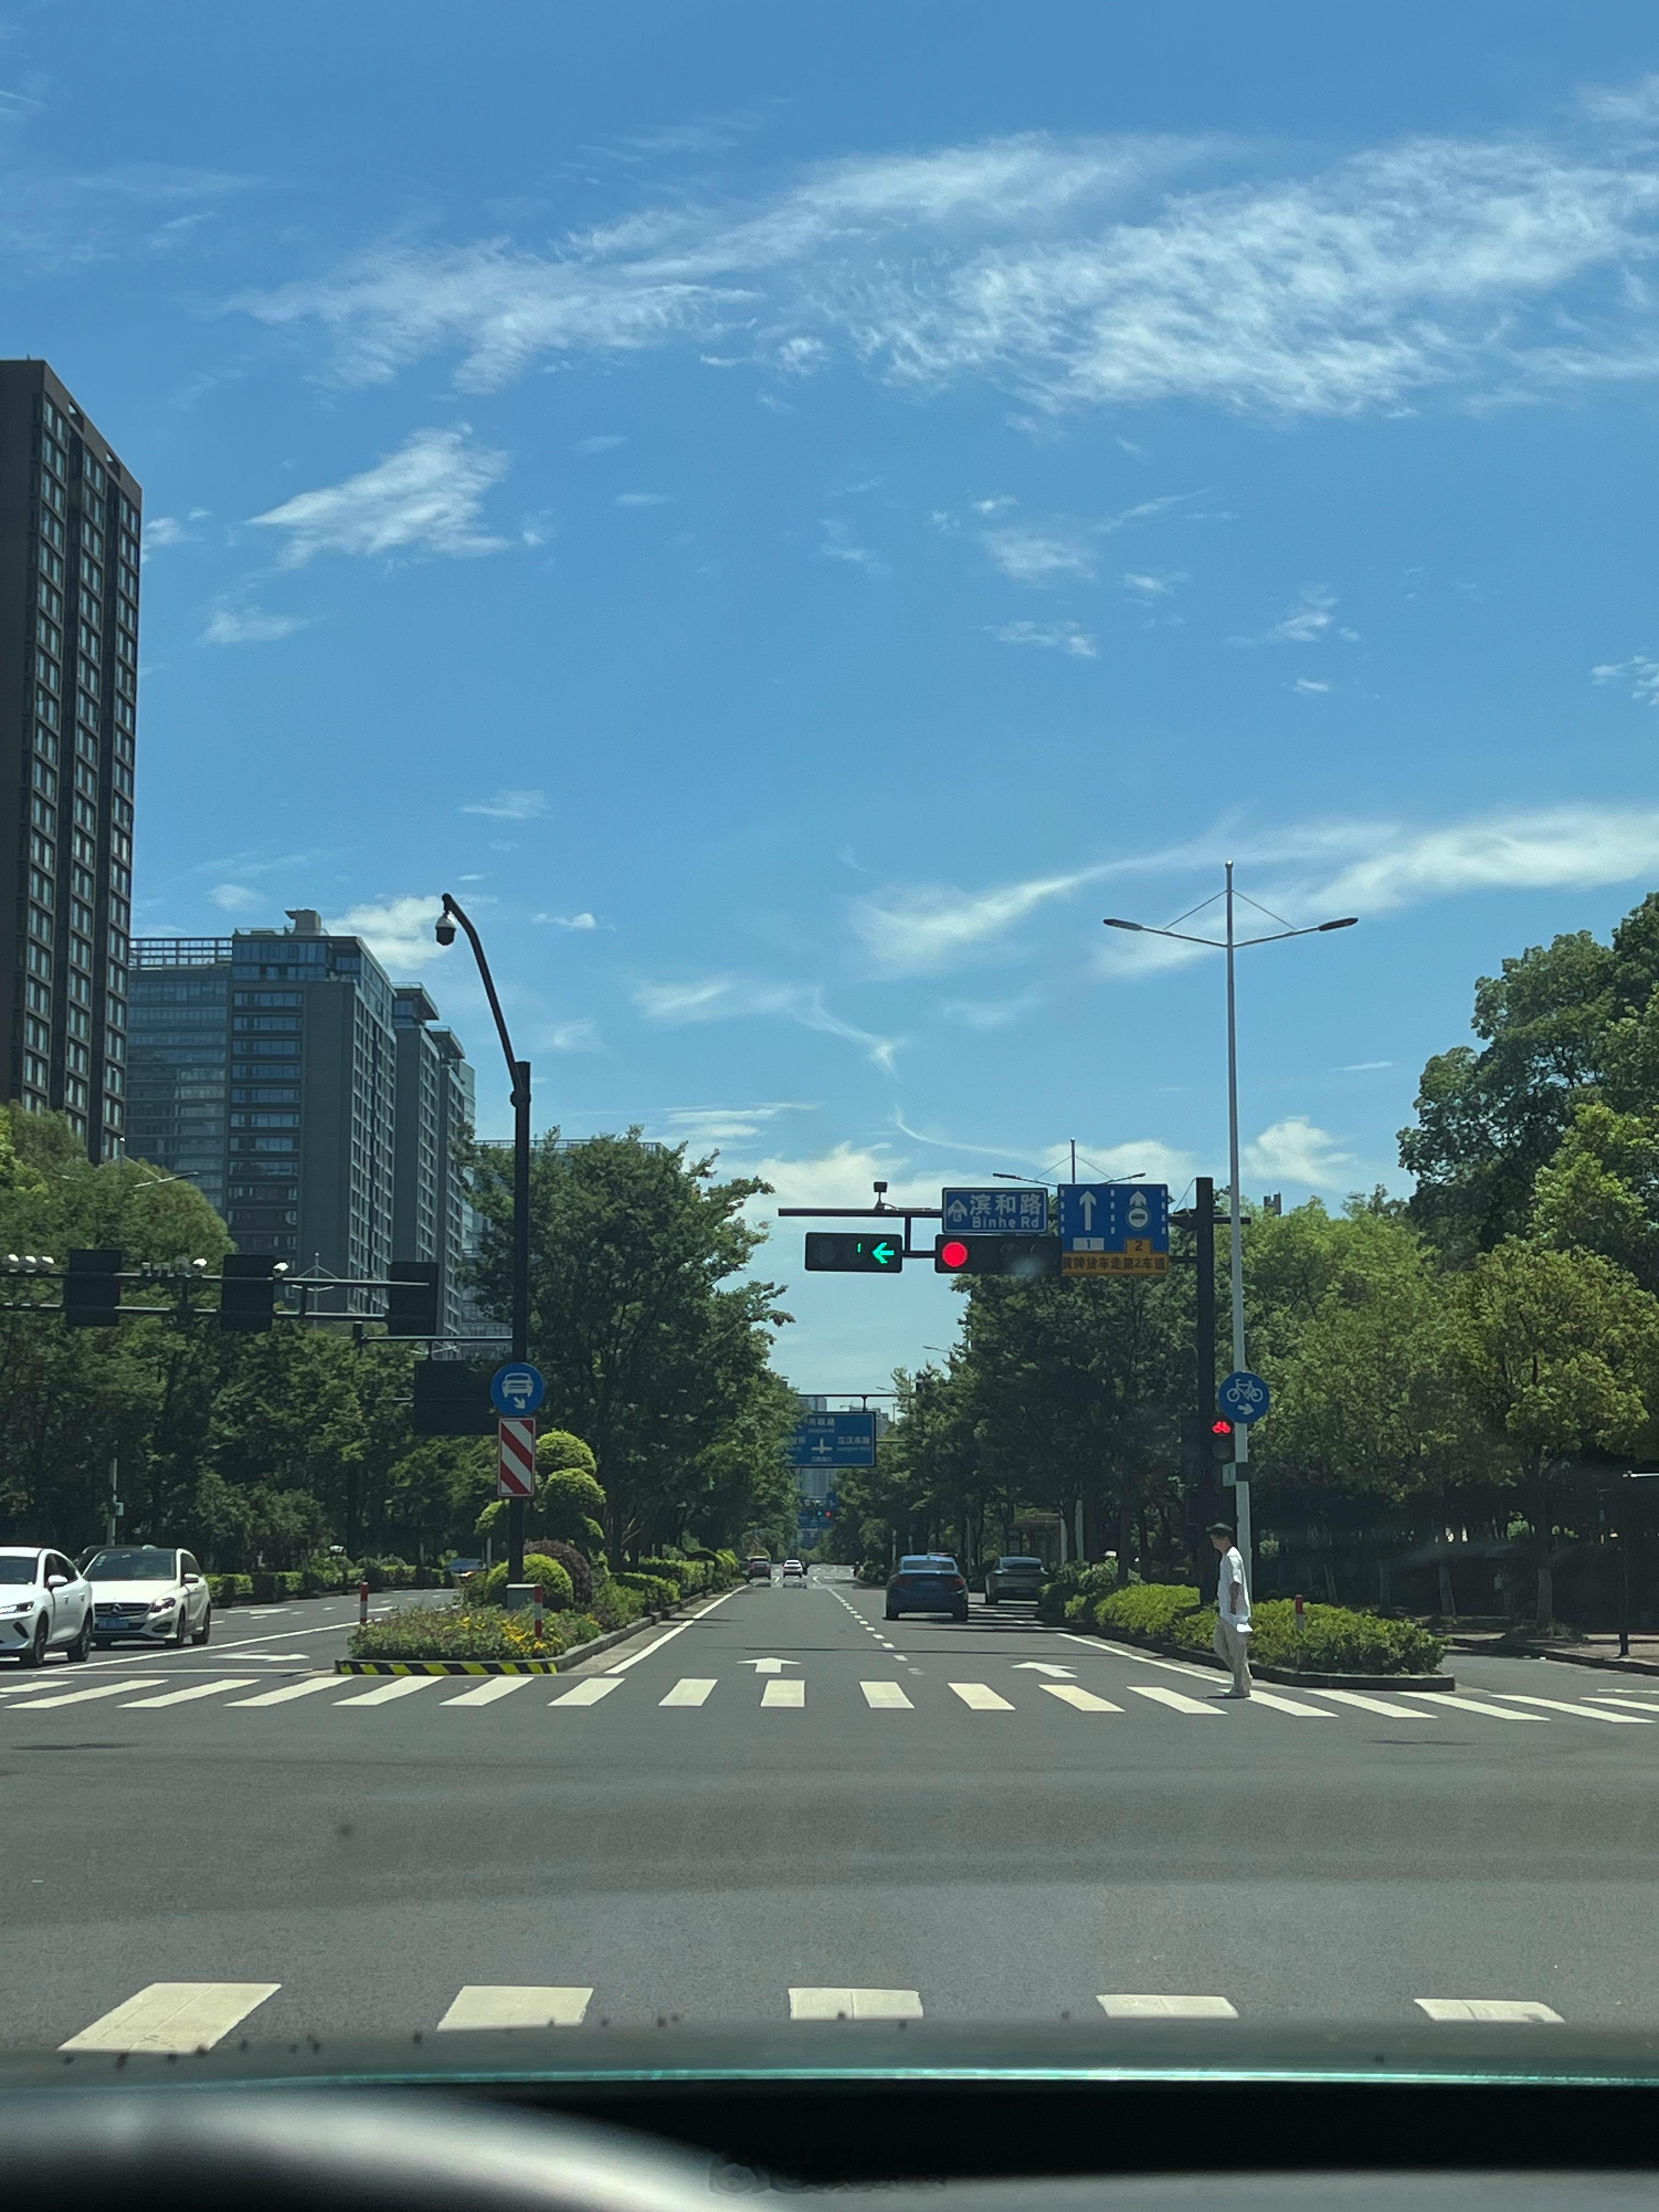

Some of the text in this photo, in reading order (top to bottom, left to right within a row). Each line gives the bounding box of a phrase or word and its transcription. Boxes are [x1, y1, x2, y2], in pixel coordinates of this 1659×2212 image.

[969, 1193, 1042, 1216] 滨和路
[972, 1216, 1039, 1228] Binhe Rd
[1086, 1239, 1091, 1249] 1
[1135, 1240, 1143, 1251] 2
